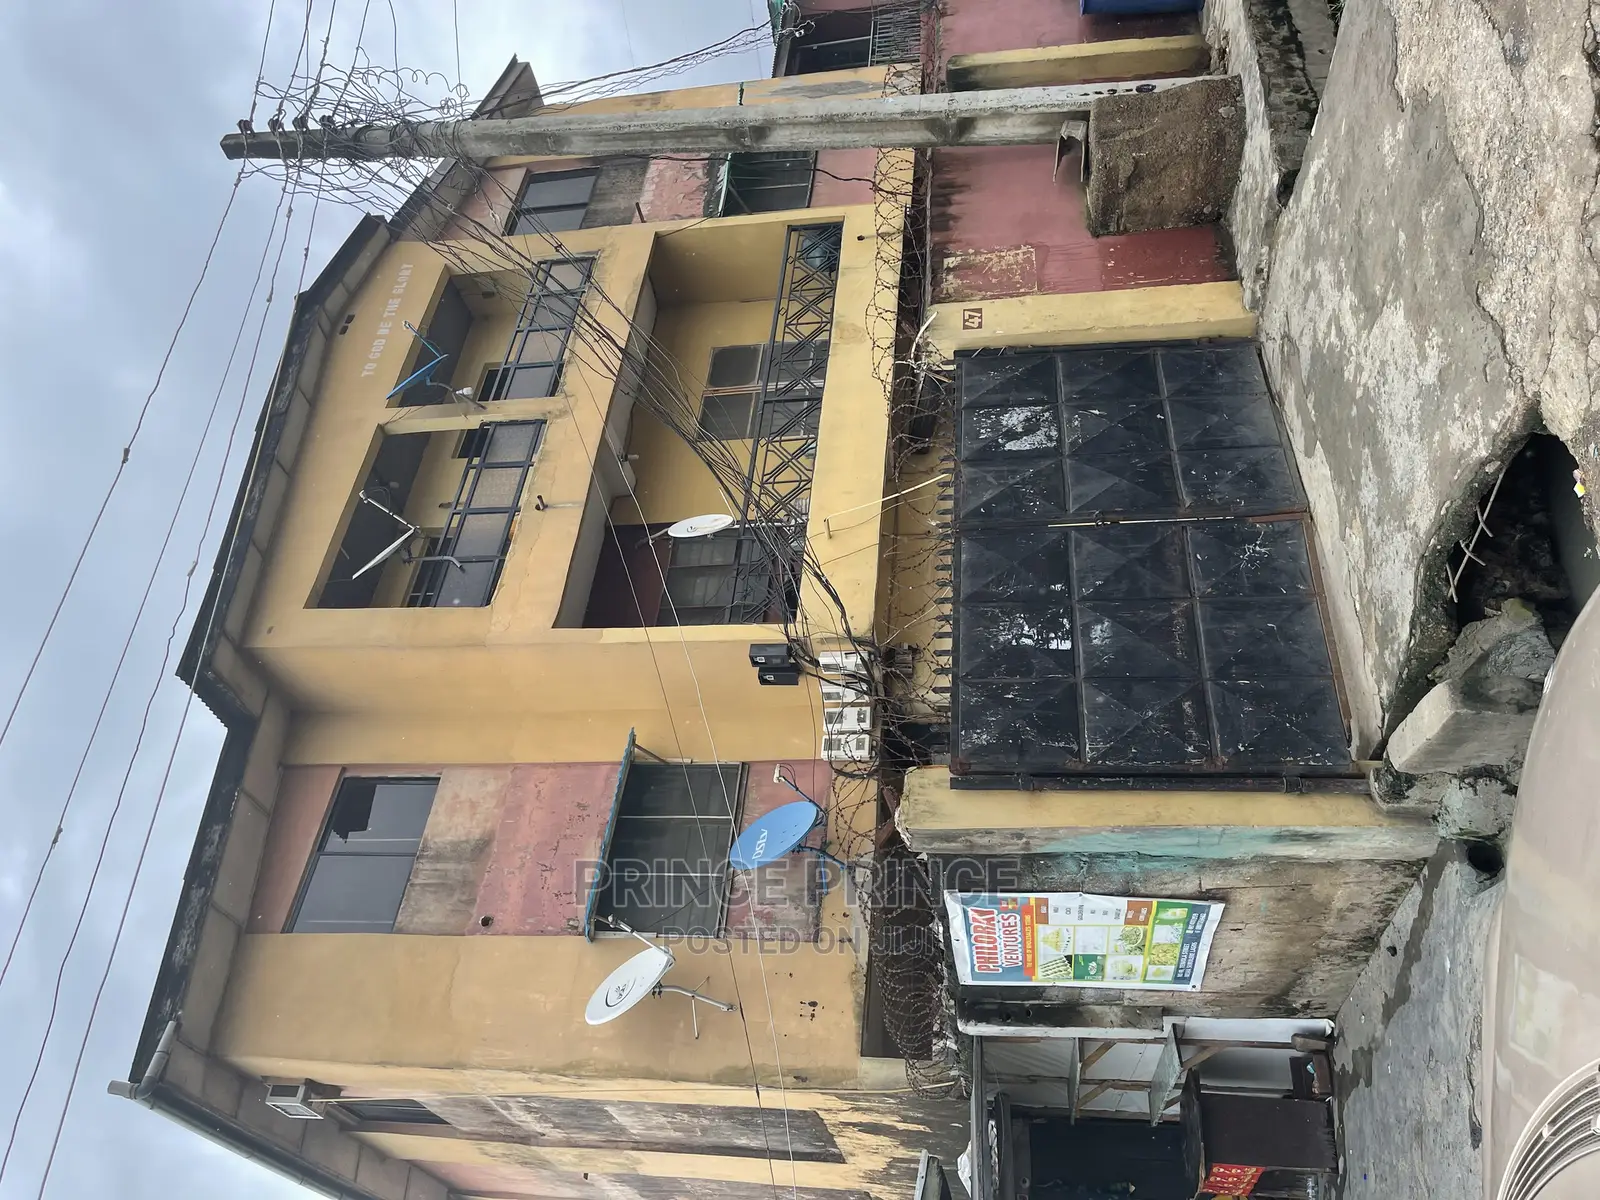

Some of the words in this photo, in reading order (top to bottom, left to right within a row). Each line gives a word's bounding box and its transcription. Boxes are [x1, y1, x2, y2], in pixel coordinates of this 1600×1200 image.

[392, 263, 414, 294] GLORY
[383, 298, 401, 318] THE
[376, 321, 392, 335] BE
[964, 311, 982, 328] 47
[368, 339, 386, 359] GOD
[361, 363, 377, 377] TO
[969, 907, 1001, 973] PHILORAY
[1001, 913, 1020, 967] VENTURES
